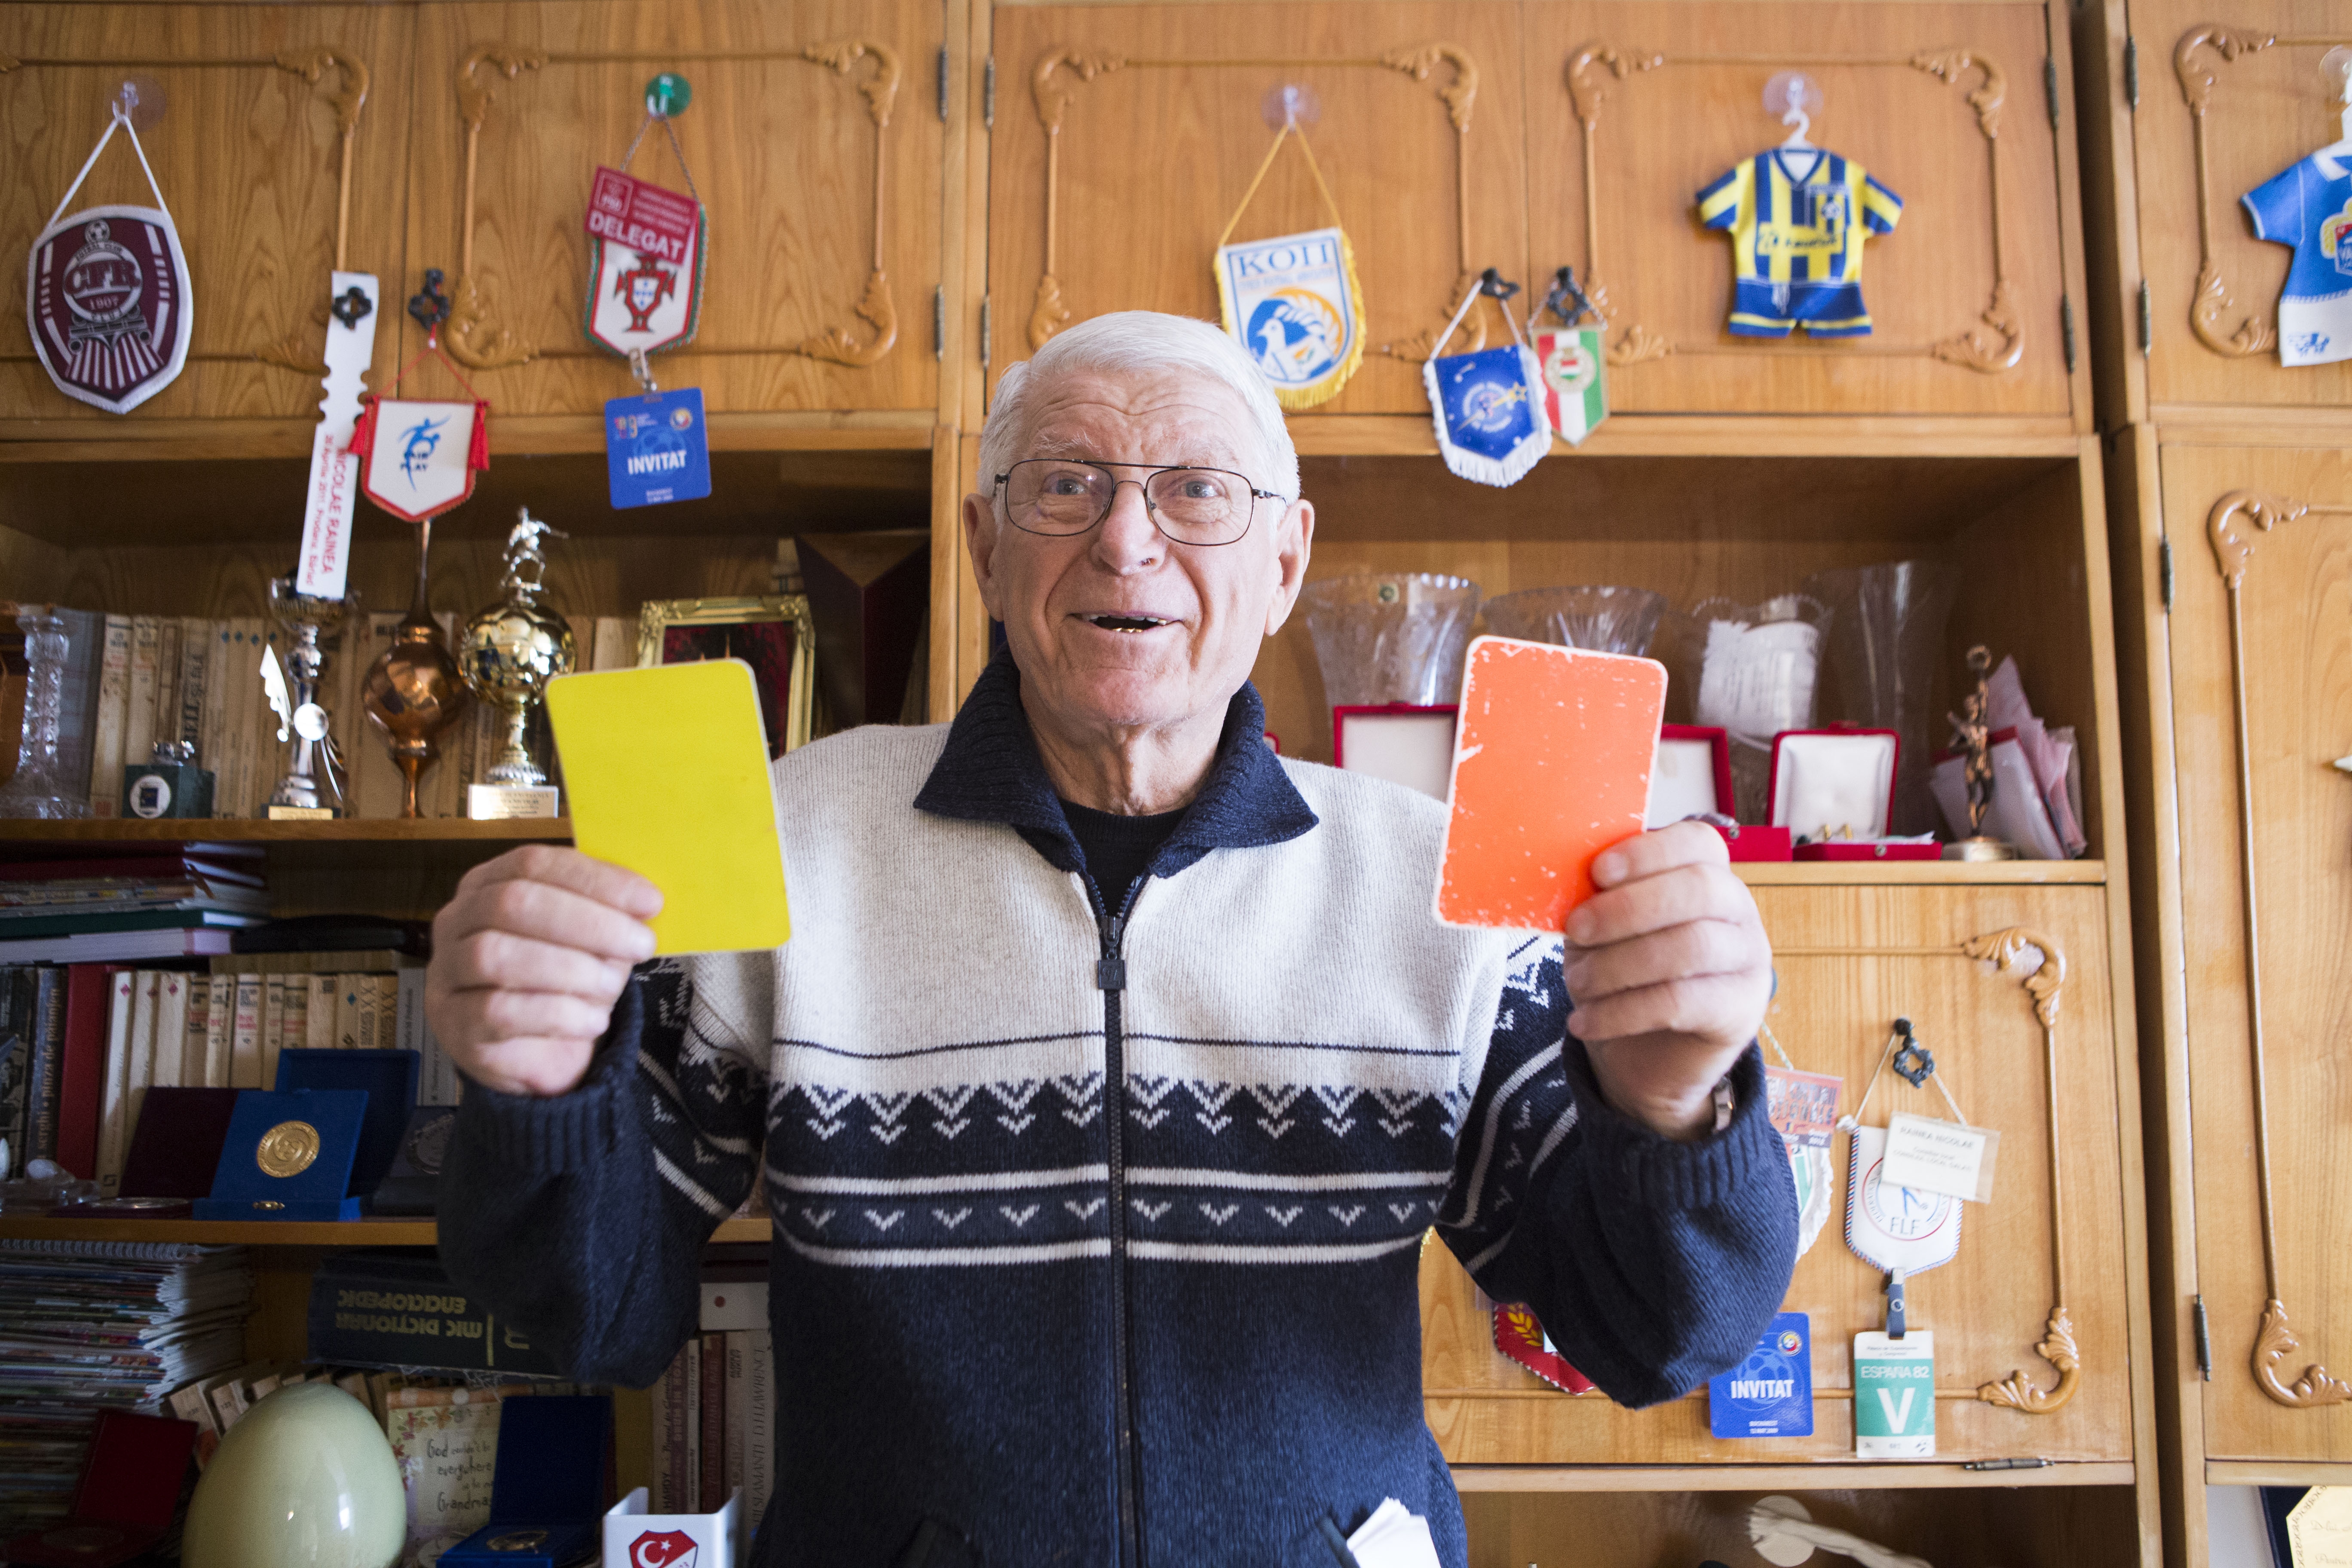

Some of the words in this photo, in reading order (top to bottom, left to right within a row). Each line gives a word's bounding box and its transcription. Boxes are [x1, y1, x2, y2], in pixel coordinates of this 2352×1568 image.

[589, 210, 684, 260] DELEGAT
[64, 259, 141, 294] CFR
[89, 295, 119, 310] 1907
[400, 462, 428, 471] PAY
[628, 449, 687, 475] INVITAT
[328, 448, 347, 514] NICOLAE
[321, 518, 340, 574] RAINEA
[1899, 1125, 1933, 1140] RAINEA
[1935, 1133, 1975, 1149] NICOLAE
[1890, 1217, 1920, 1235] FLF
[444, 1319, 484, 1340] MIC
[1912, 1366, 1930, 1378] 82
[1730, 1379, 1795, 1399] INVITAT
[1877, 1387, 1916, 1434] V
[426, 1438, 449, 1458] God
[662, 1472, 671, 1509] HARDY
